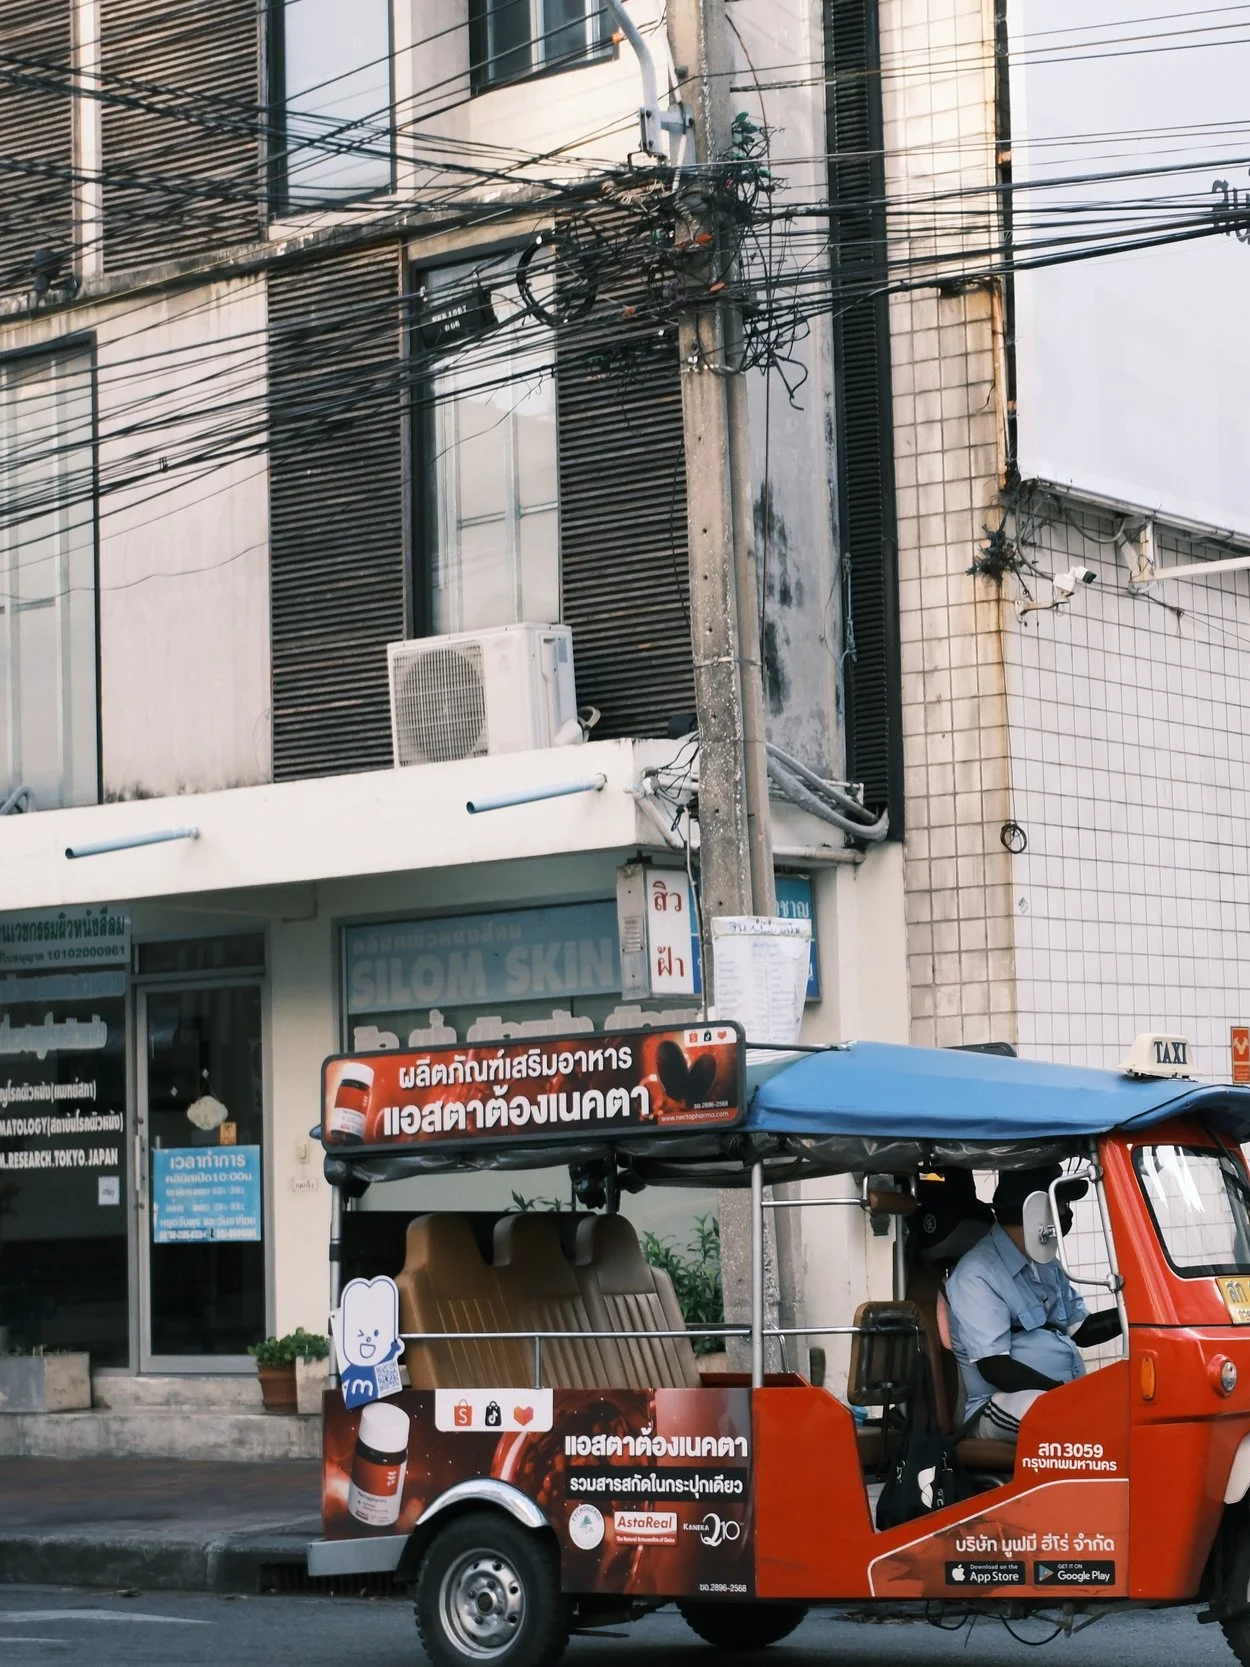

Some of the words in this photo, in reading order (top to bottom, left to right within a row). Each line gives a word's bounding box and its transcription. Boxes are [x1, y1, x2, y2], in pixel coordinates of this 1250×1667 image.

[652, 880, 683, 912] สิว
[48, 945, 125, 960] 10102000961
[656, 945, 685, 978] ฝ้า
[352, 948, 487, 1007] SILOM
[505, 938, 614, 995] SKIN
[1153, 1040, 1188, 1065] TAXI
[399, 1046, 633, 1089] ผลิตภัณฑ์เสริมอาหาร
[383, 1084, 650, 1137] แอสตาต้องเนคตา
[170, 1150, 246, 1169] เวลาทำการ
[565, 1427, 748, 1457] แอสตาต้องเนคตา
[1038, 1442, 1062, 1457] สก
[1063, 1443, 1104, 1459] 3059
[1022, 1457, 1118, 1473] กรุงเทพมหานคร
[570, 1472, 743, 1499] รวมสารสกัดในกระปุกเดียว
[617, 1515, 673, 1529] AstaReal
[700, 1512, 741, 1547] Q10
[955, 1535, 998, 1552] บริษัท
[1002, 1533, 1037, 1558] มูฟมี
[1041, 1532, 1070, 1552] ฮีโร่
[1073, 1532, 1115, 1552] จำกัด
[970, 1572, 992, 1583] App
[992, 1572, 1019, 1582] Store
[1057, 1571, 1090, 1583] Google
[1092, 1571, 1111, 1583] Play
